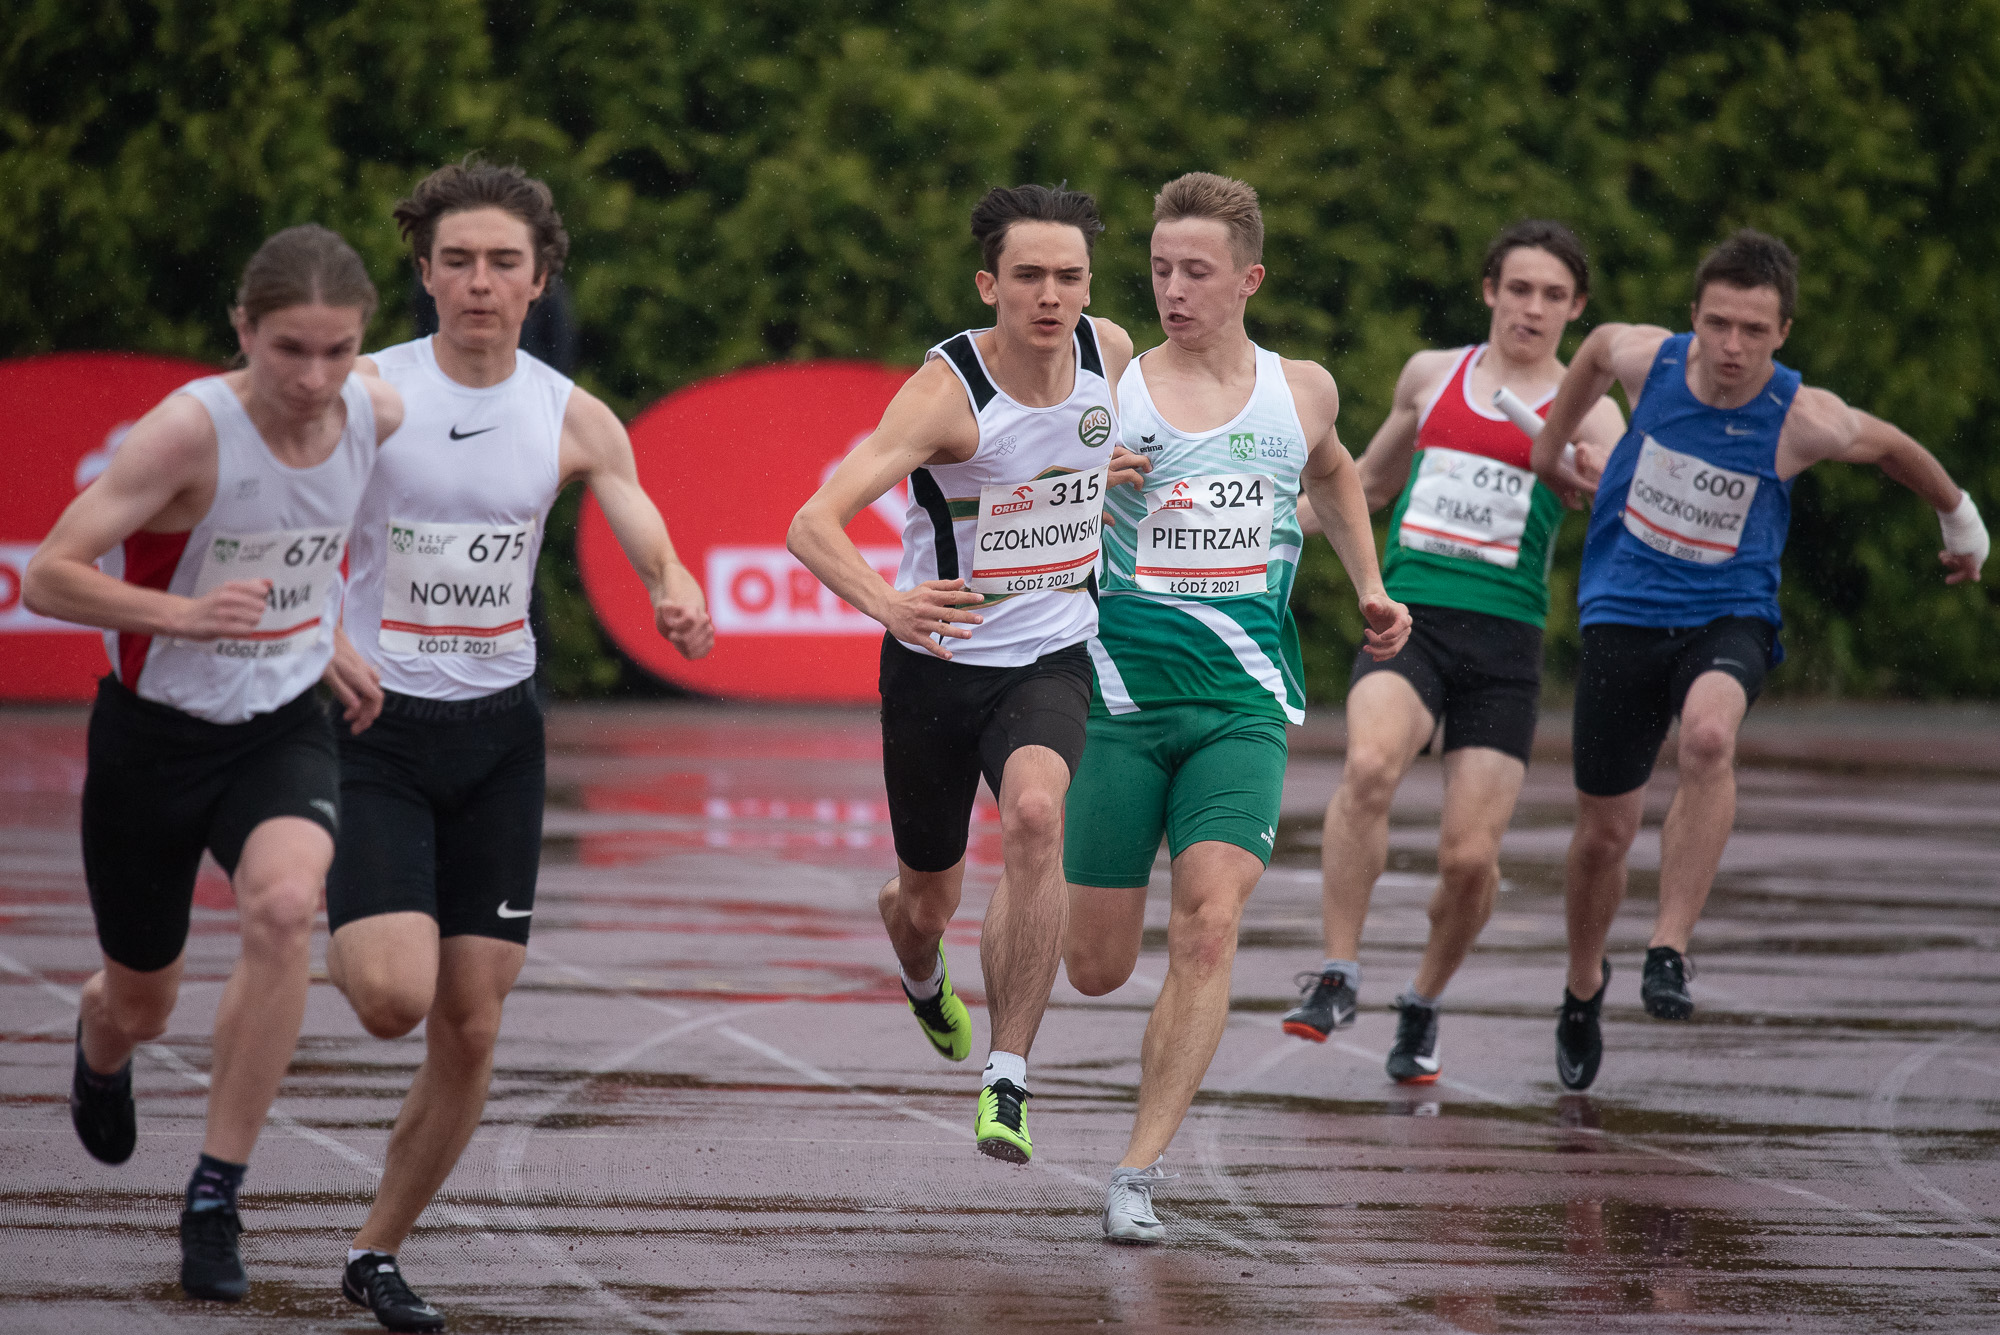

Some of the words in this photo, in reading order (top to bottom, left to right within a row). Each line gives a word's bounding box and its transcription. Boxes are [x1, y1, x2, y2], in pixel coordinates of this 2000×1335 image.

[1084, 411, 1107, 432] RKS
[1140, 444, 1164, 453] erima
[1049, 473, 1099, 507] 315
[1208, 480, 1264, 508] 324
[1473, 465, 1522, 497] 610
[1693, 470, 1746, 500] 600
[993, 501, 1031, 515] ORLEN
[1633, 478, 1741, 532] GORZKOWICZ
[980, 514, 1099, 552] CZOŁNOWSKI
[1152, 526, 1261, 550] PIETRZAK
[284, 533, 341, 567] 676
[468, 531, 526, 563] 675
[410, 581, 513, 608] NOWAK
[1006, 574, 1044, 592] ŁÓDŹ
[1047, 572, 1075, 588] 2021
[1170, 578, 1208, 594] ŁÓDŹ
[1211, 580, 1240, 594] 2021
[418, 636, 458, 654] ŁÓDŹ
[464, 640, 497, 655] 2021
